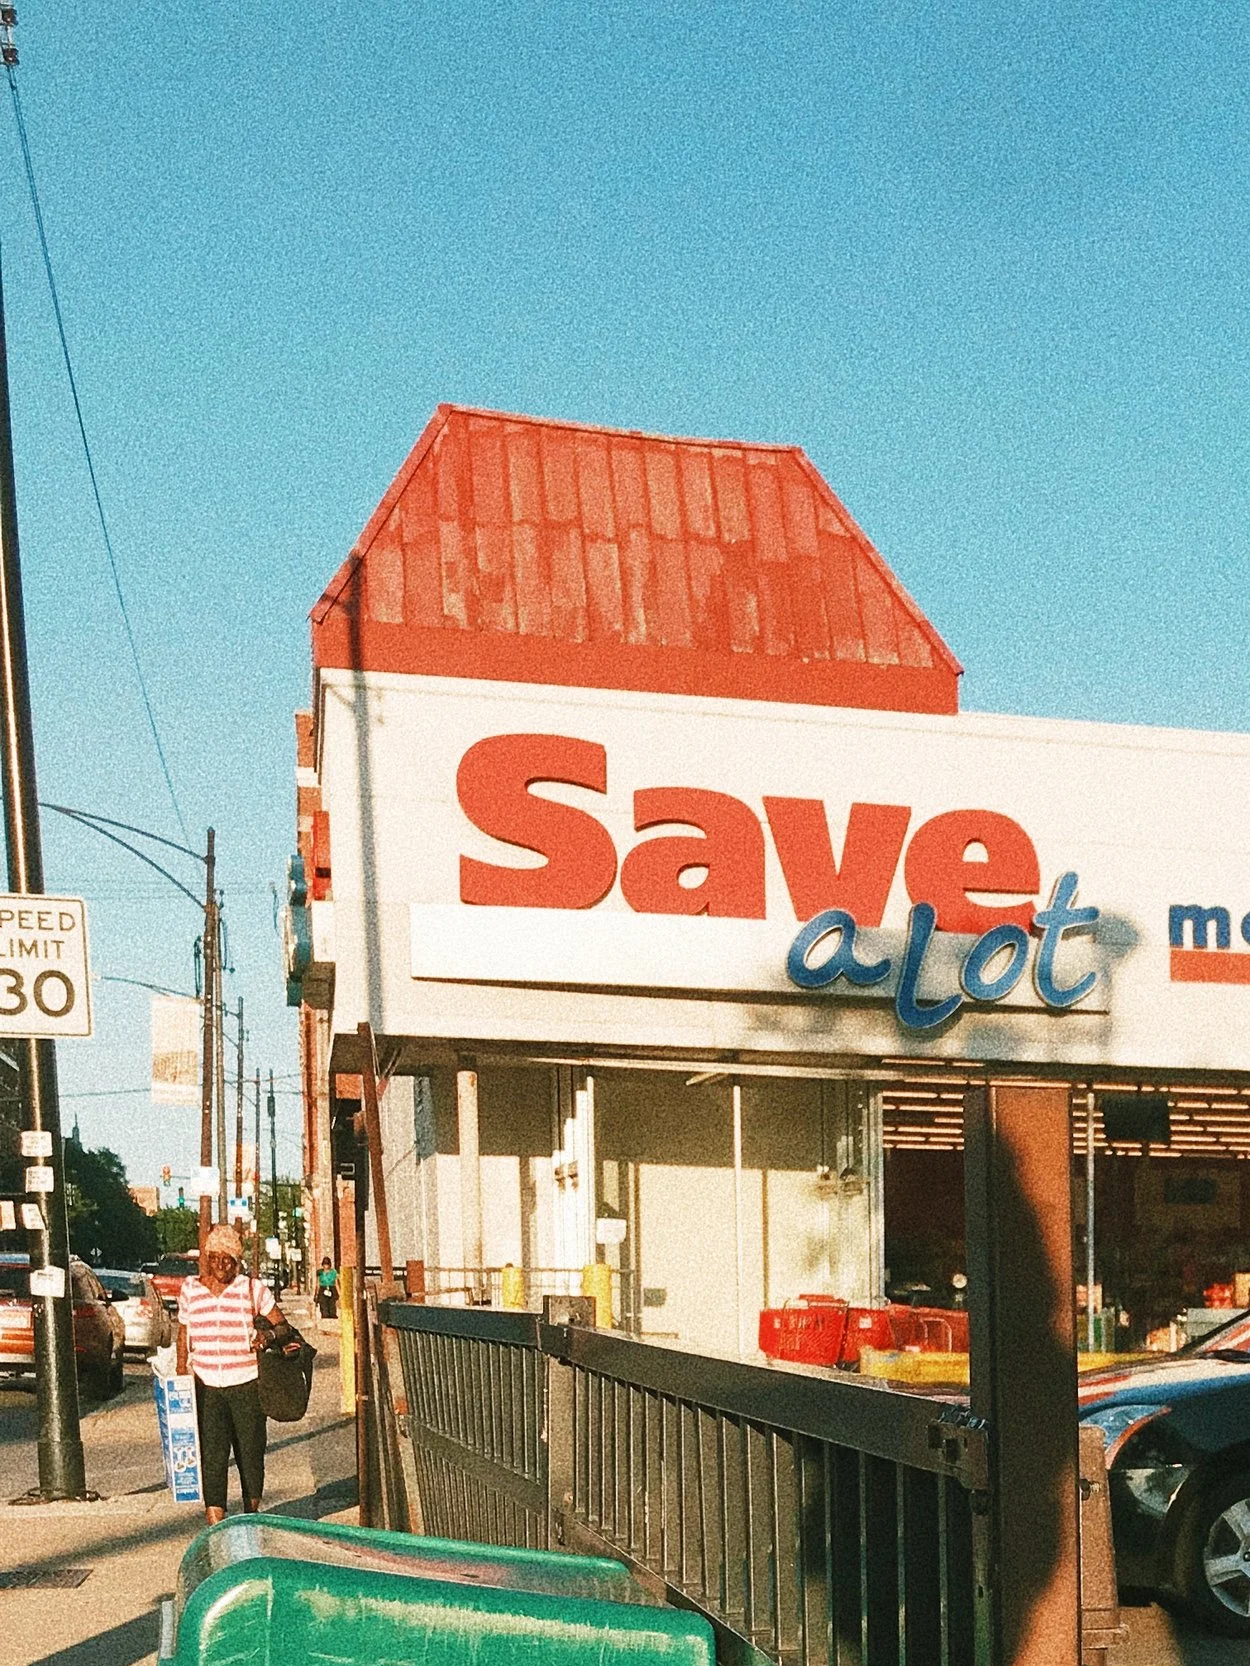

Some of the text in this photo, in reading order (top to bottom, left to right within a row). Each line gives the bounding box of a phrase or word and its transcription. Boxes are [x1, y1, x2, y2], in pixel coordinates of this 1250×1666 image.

[456, 733, 1041, 935] Save
[0, 909, 76, 932] PEED
[785, 908, 891, 988] a
[0, 968, 75, 1018] 30
